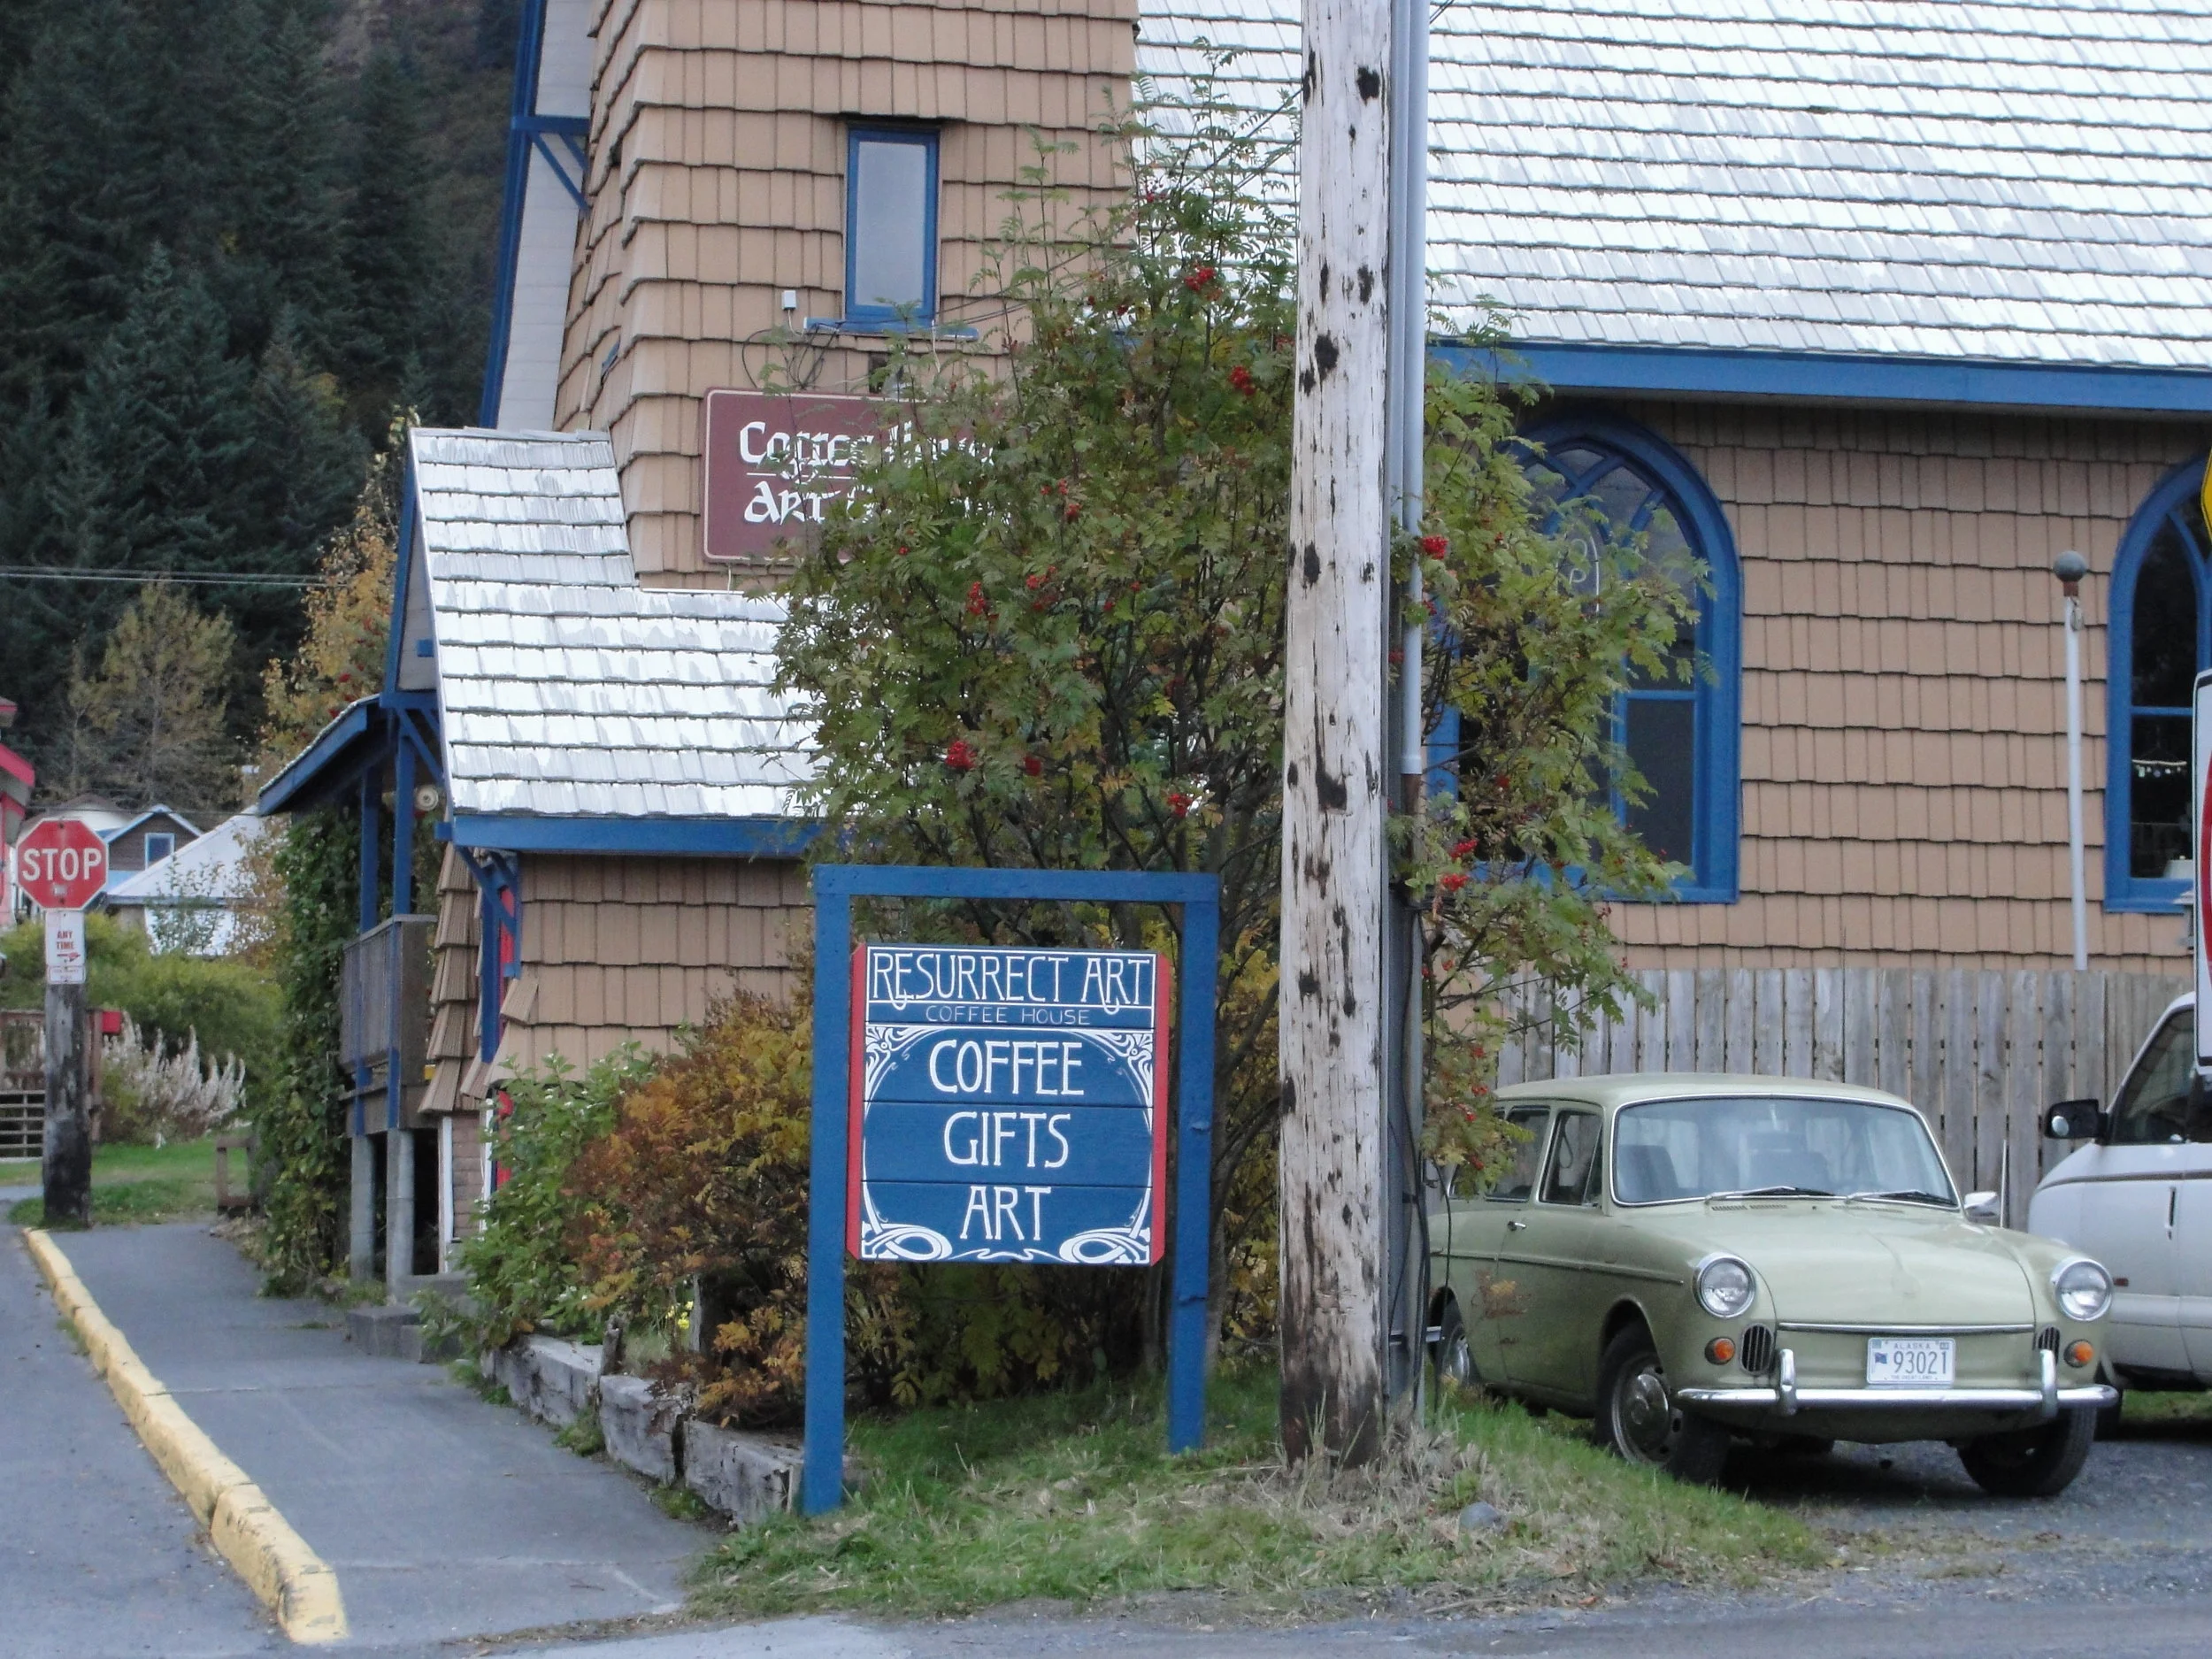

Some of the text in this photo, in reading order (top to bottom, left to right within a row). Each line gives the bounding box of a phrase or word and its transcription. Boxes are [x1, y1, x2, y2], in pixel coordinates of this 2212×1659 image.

[22, 848, 102, 881] STOP
[872, 952, 1150, 1015] RESURRECT ART
[926, 1004, 1091, 1025] COFFEE HOUSE
[929, 1039, 1085, 1096] COFFEE
[943, 1111, 1071, 1169] GIFTS
[959, 1186, 1051, 1241] ART
[1893, 1350, 1947, 1374] 93021
